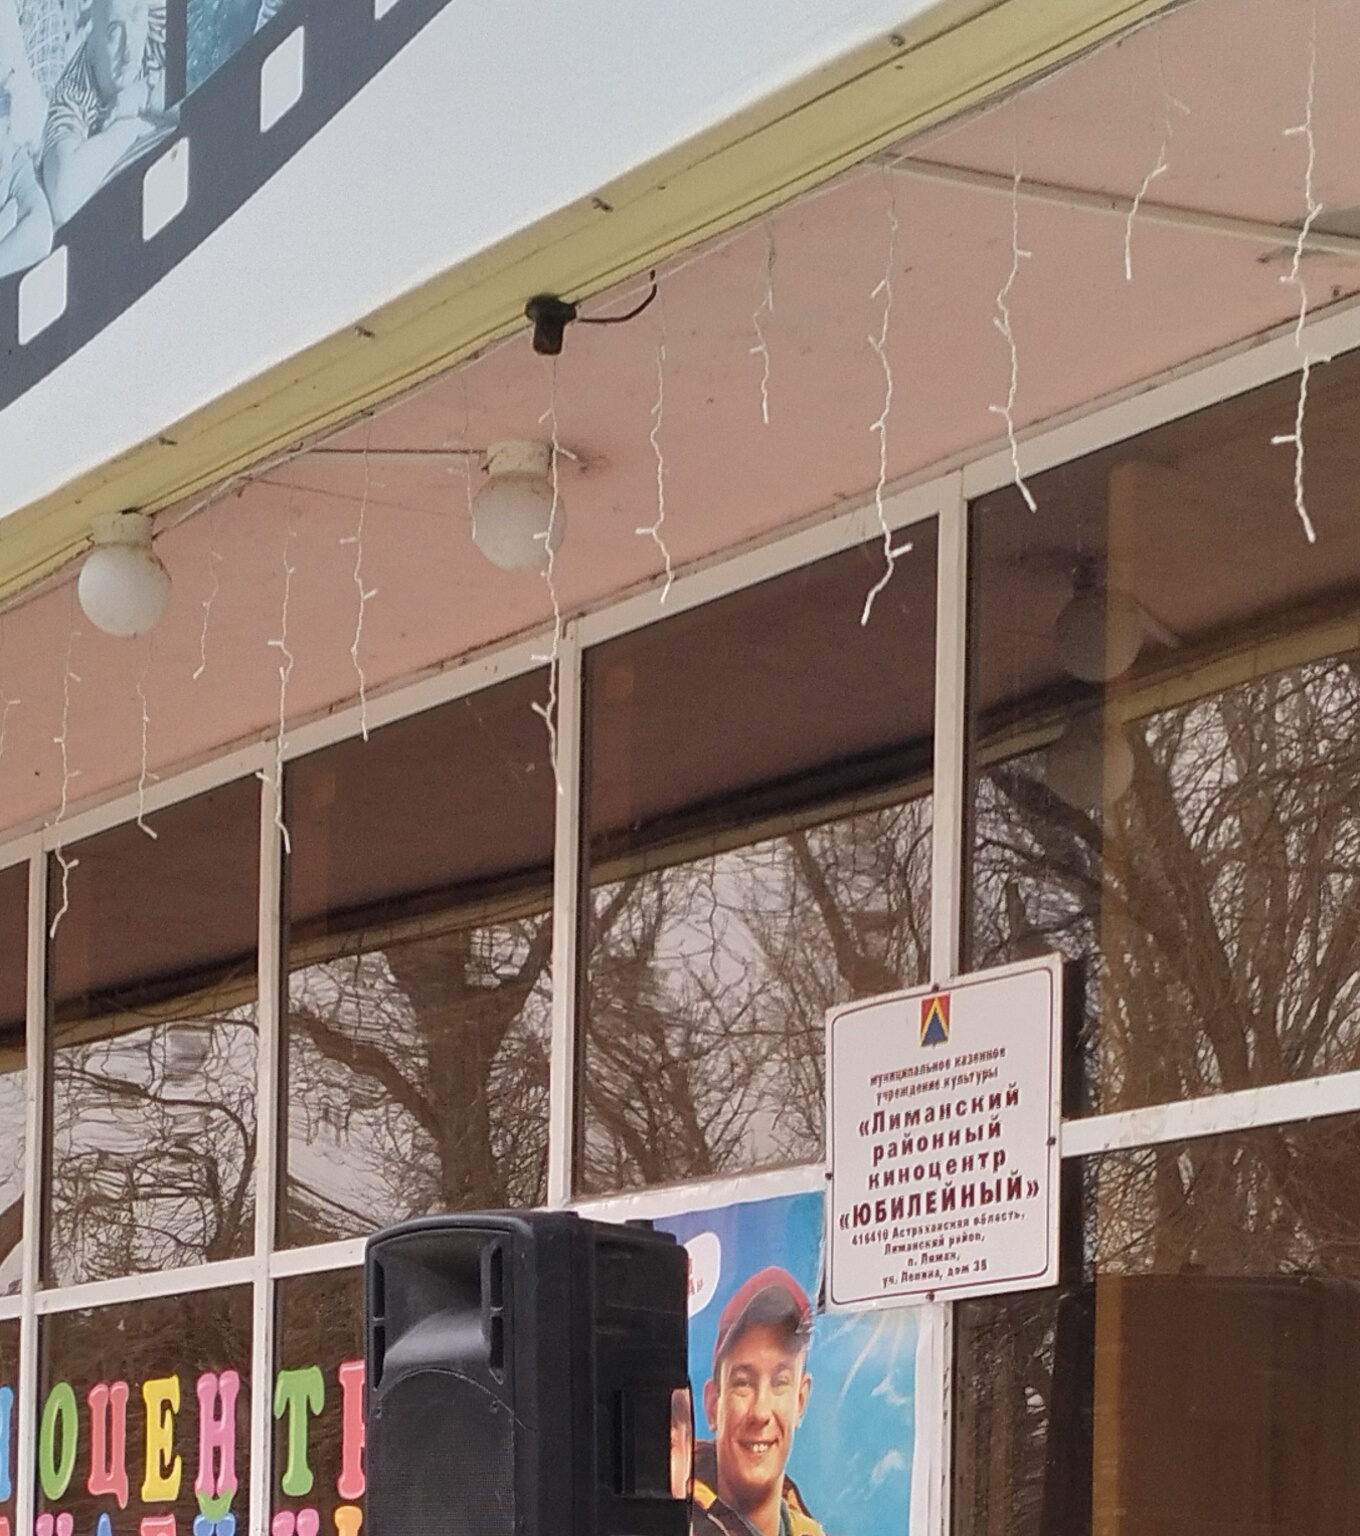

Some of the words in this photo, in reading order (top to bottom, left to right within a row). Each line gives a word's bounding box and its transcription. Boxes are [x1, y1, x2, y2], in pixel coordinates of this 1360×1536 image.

[943, 1067, 998, 1090] культуры
[859, 1082, 1019, 1137] «Лиманский
[873, 1114, 1002, 1167] районный
[869, 1150, 1006, 1190] киноцентр
[840, 1169, 1040, 1230] «ЮБИЛЕЙНЫЙ»
